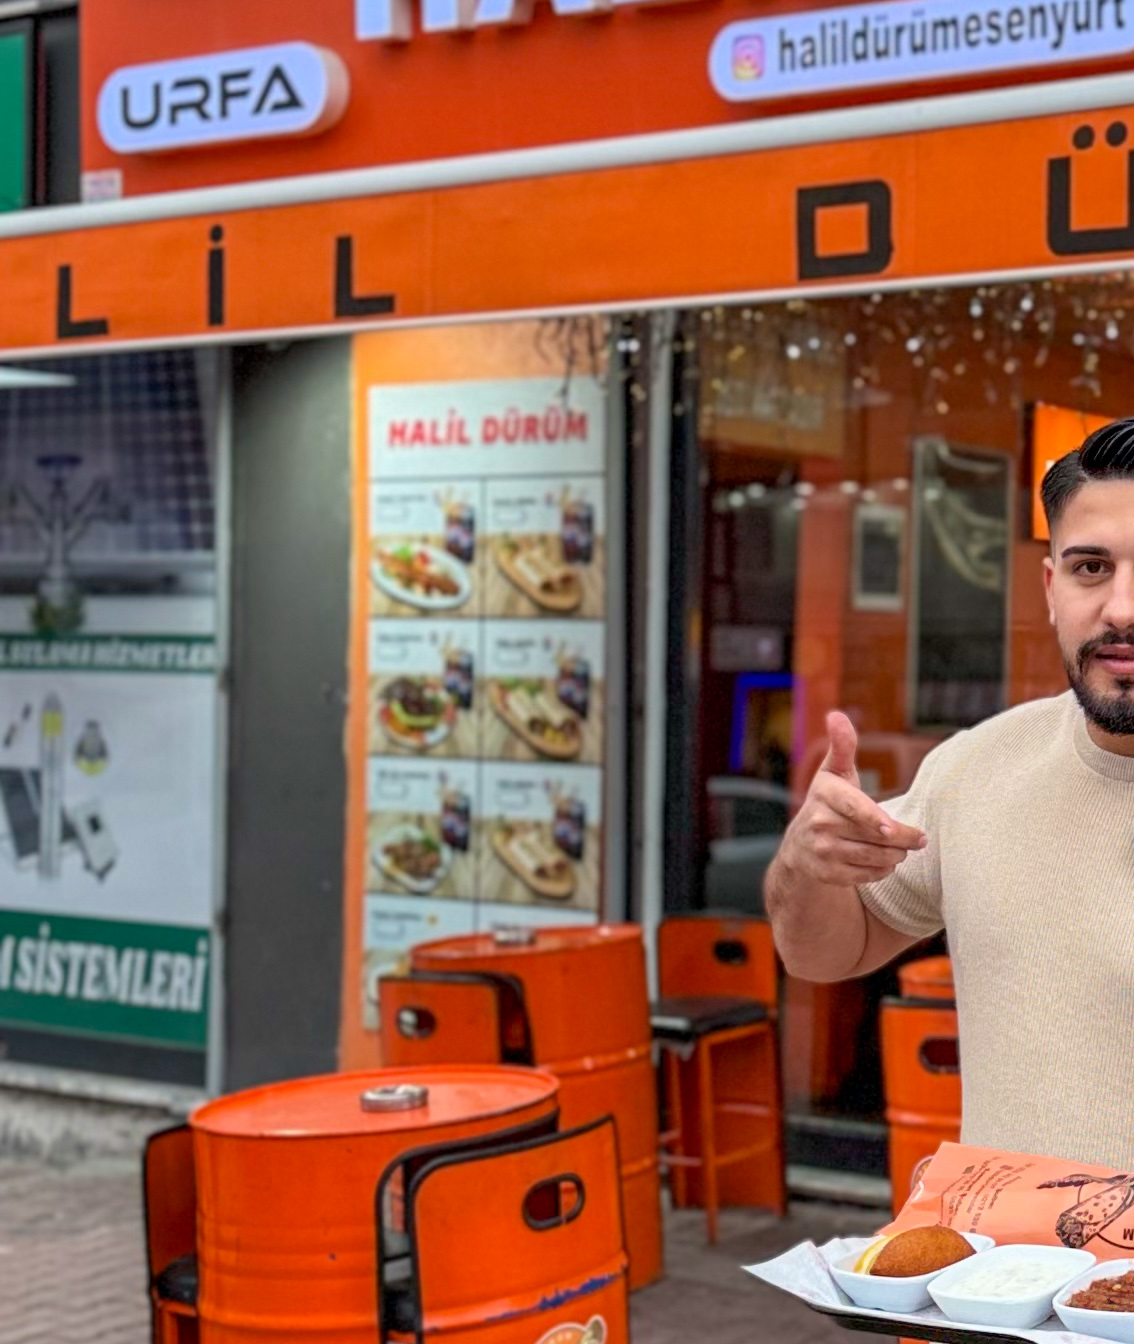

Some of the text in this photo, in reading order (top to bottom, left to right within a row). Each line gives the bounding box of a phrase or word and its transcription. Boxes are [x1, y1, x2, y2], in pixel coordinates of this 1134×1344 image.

[121, 61, 305, 131] URFA
[388, 405, 588, 447] HALİL DÜRÜM
[14, 920, 208, 1013] SİSTEMLERİ
